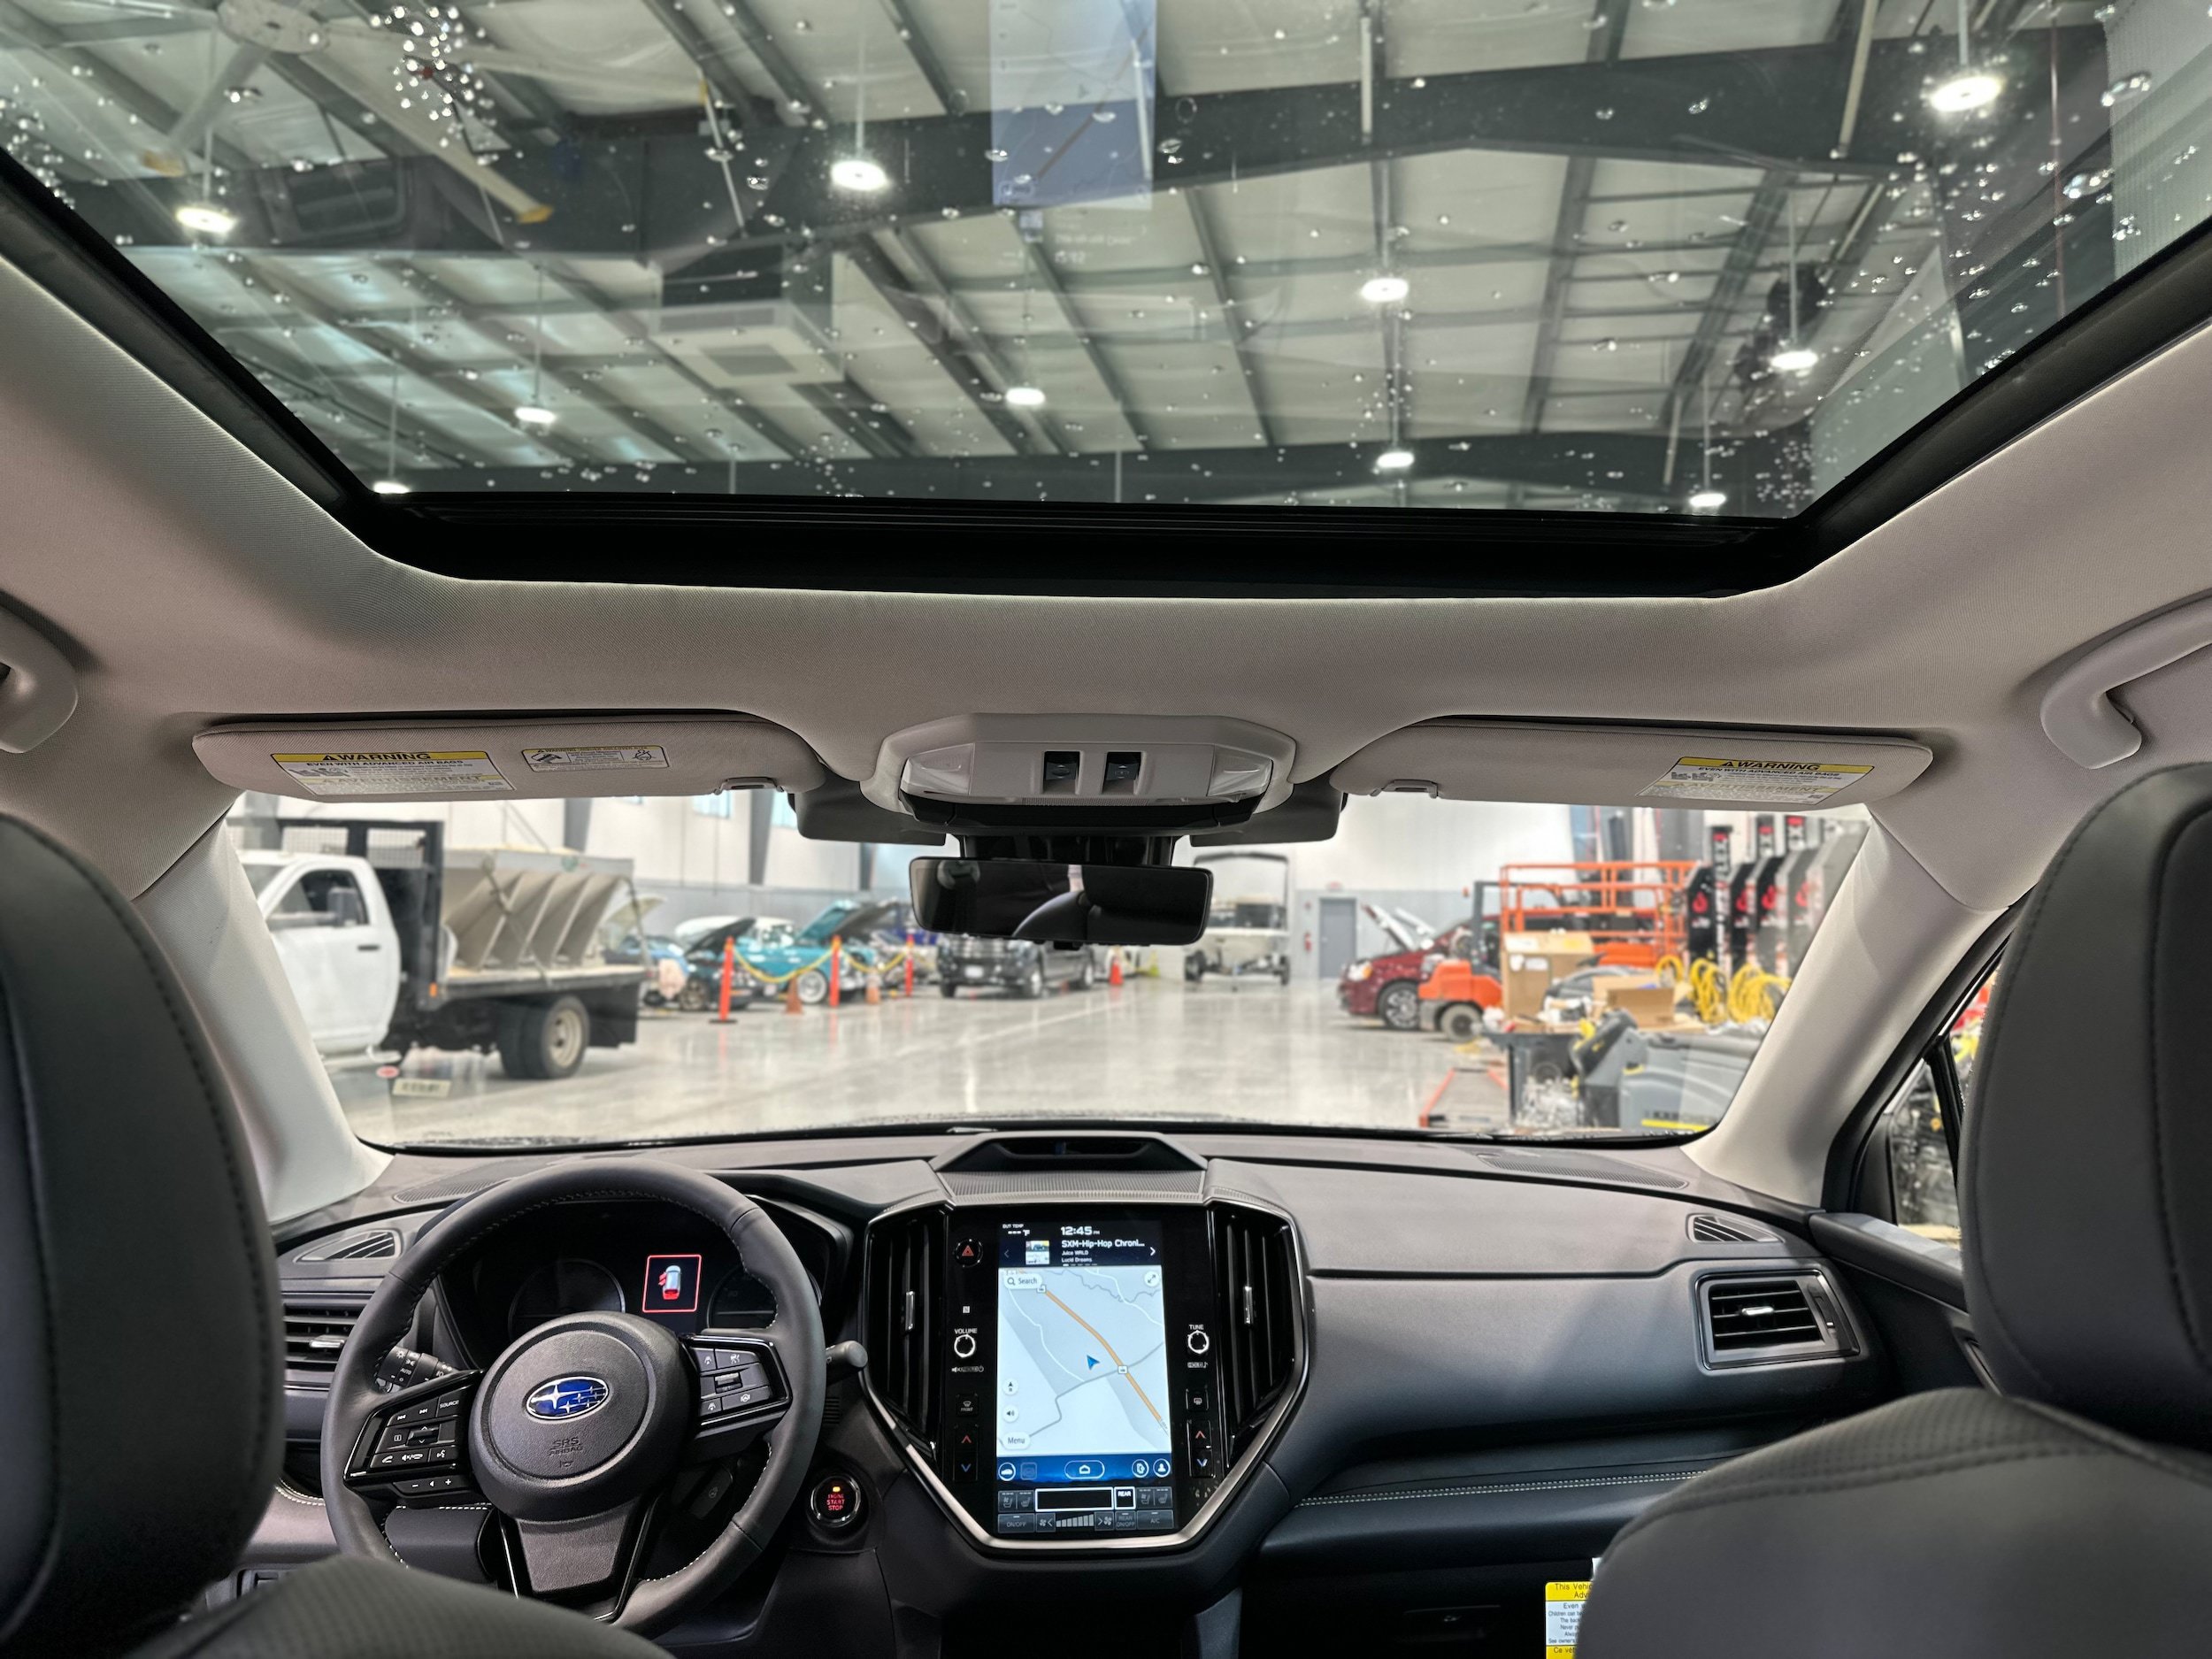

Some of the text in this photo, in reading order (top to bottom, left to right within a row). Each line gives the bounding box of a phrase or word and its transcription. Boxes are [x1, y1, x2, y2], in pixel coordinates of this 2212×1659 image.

[1737, 762, 1821, 771] WARNING
[1061, 1226, 1092, 1235] 12:45
[1062, 1239, 1112, 1248] SXM-Hip-Hop
[440, 1400, 459, 1409] SOURCE
[552, 1437, 580, 1448] SRS
[549, 1443, 584, 1455] AIRBAG
